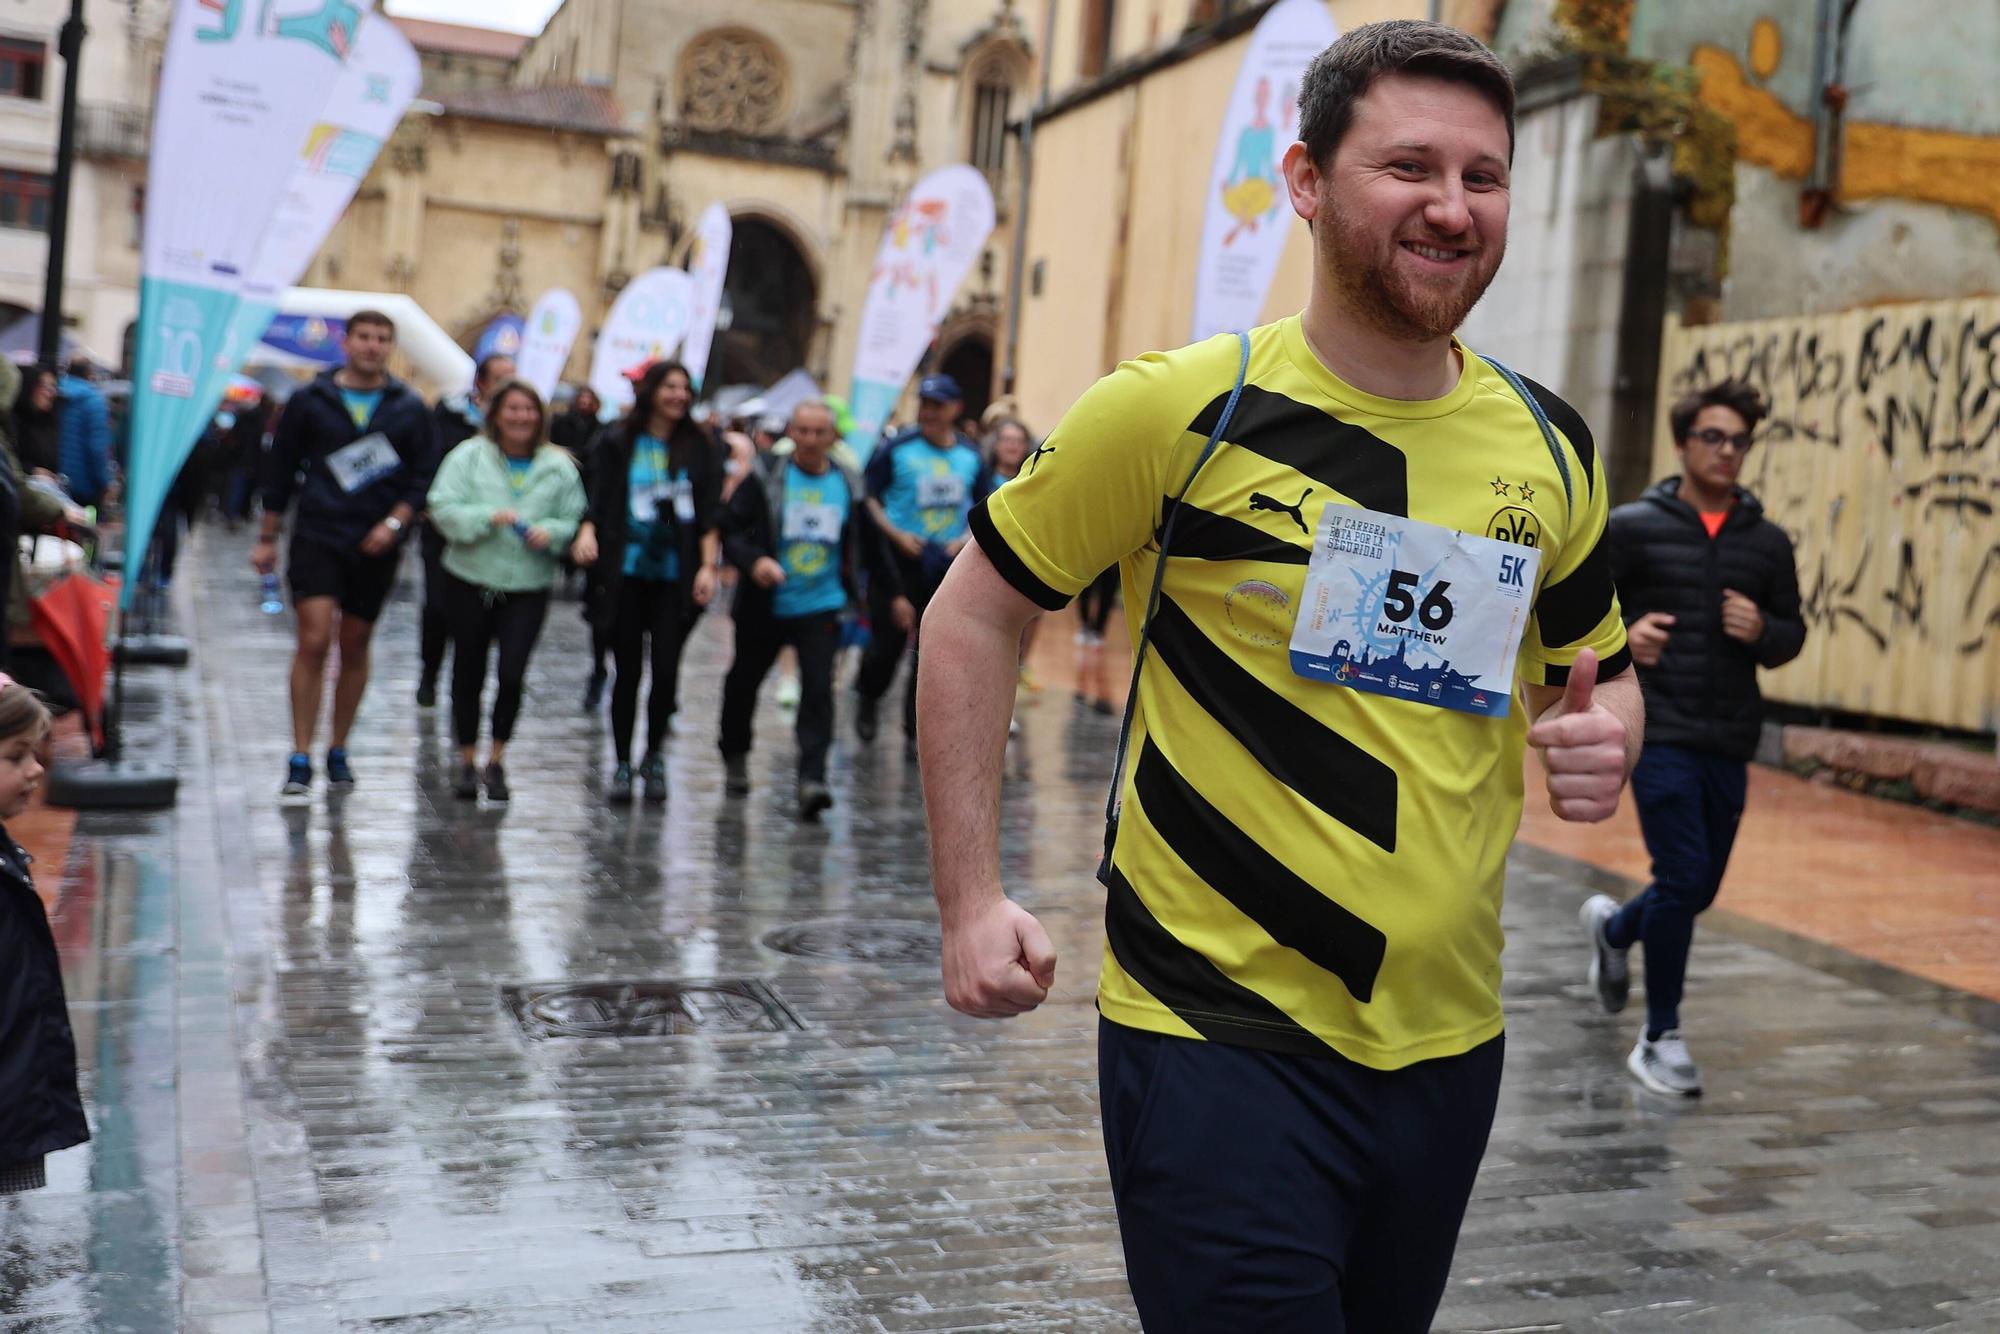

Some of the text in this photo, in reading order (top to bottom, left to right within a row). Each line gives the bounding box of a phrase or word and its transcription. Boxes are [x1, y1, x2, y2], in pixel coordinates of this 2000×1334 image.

[1331, 515, 1386, 537] IV CARRERA
[1327, 537, 1383, 560] SEGURIDAD
[1354, 531, 1372, 545] POR
[1373, 535, 1383, 548] LA
[1498, 554, 1528, 587] 5K
[1383, 569, 1454, 631] 56
[1377, 622, 1447, 646] MATTHEW
